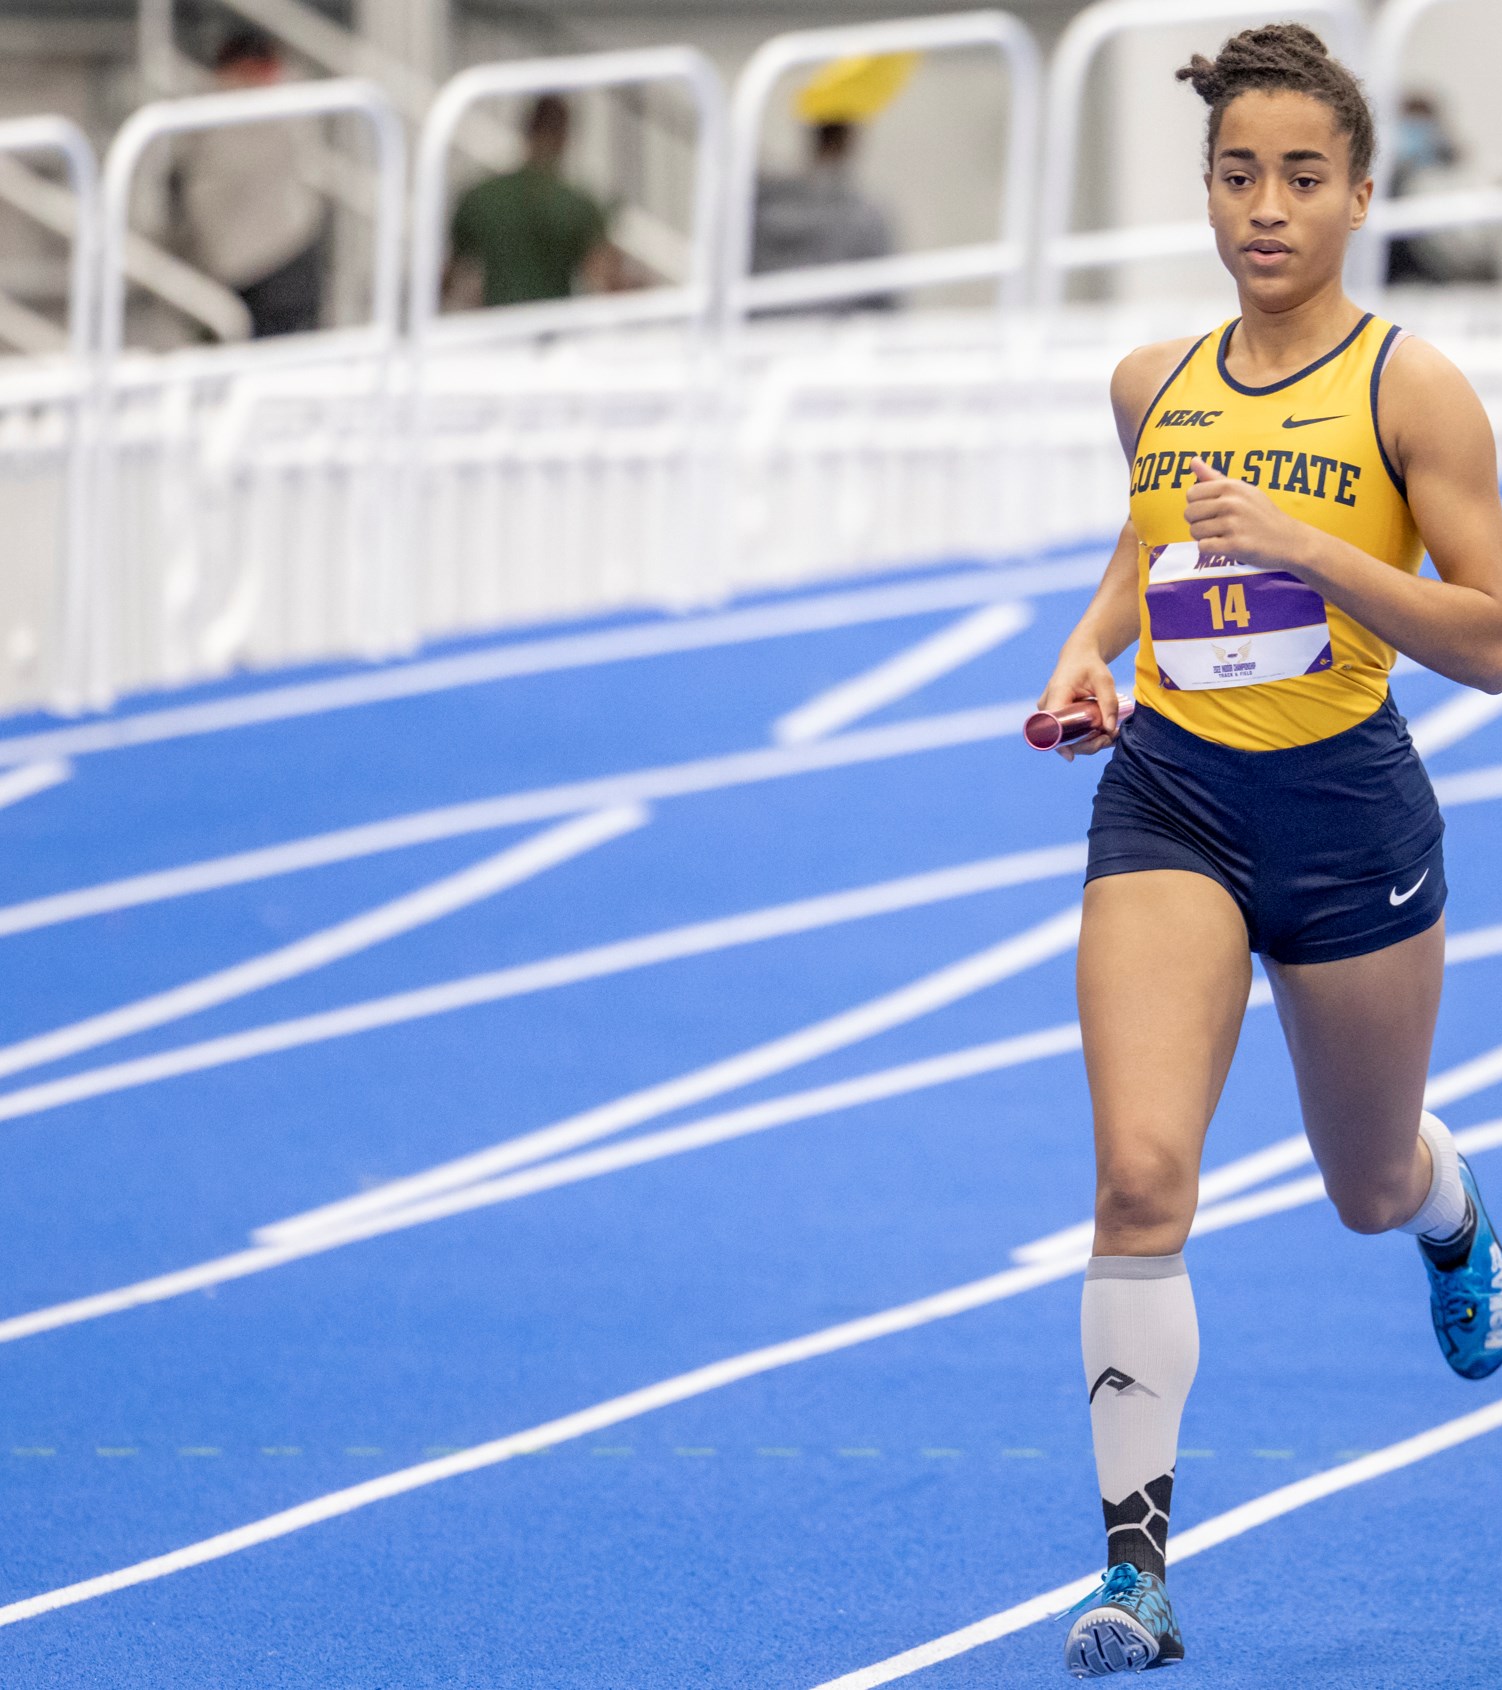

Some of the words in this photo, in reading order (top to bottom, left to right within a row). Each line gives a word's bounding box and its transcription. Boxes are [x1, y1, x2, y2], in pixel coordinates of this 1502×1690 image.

[1155, 410, 1224, 429] MEAC
[1241, 449, 1361, 507] STATE
[1203, 583, 1251, 630] 14
